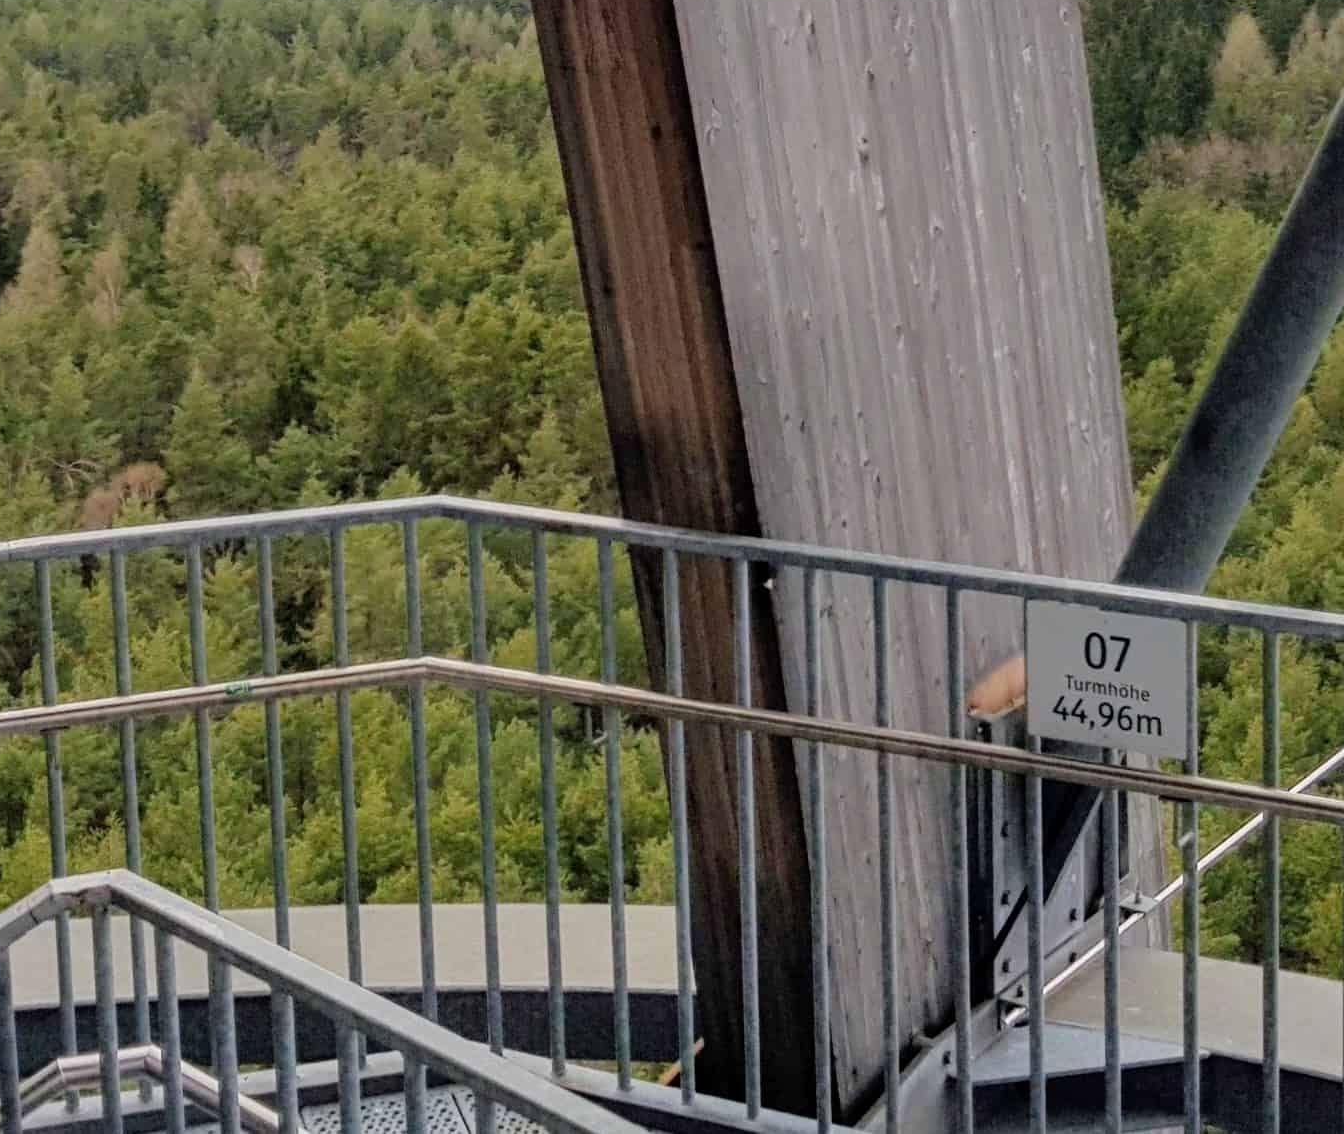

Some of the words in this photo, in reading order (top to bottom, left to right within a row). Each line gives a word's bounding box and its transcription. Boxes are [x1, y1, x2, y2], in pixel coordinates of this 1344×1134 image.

[1084, 632, 1131, 672] 07
[1065, 674, 1150, 702] Turmhöhe
[1052, 696, 1162, 736] 44,96m
